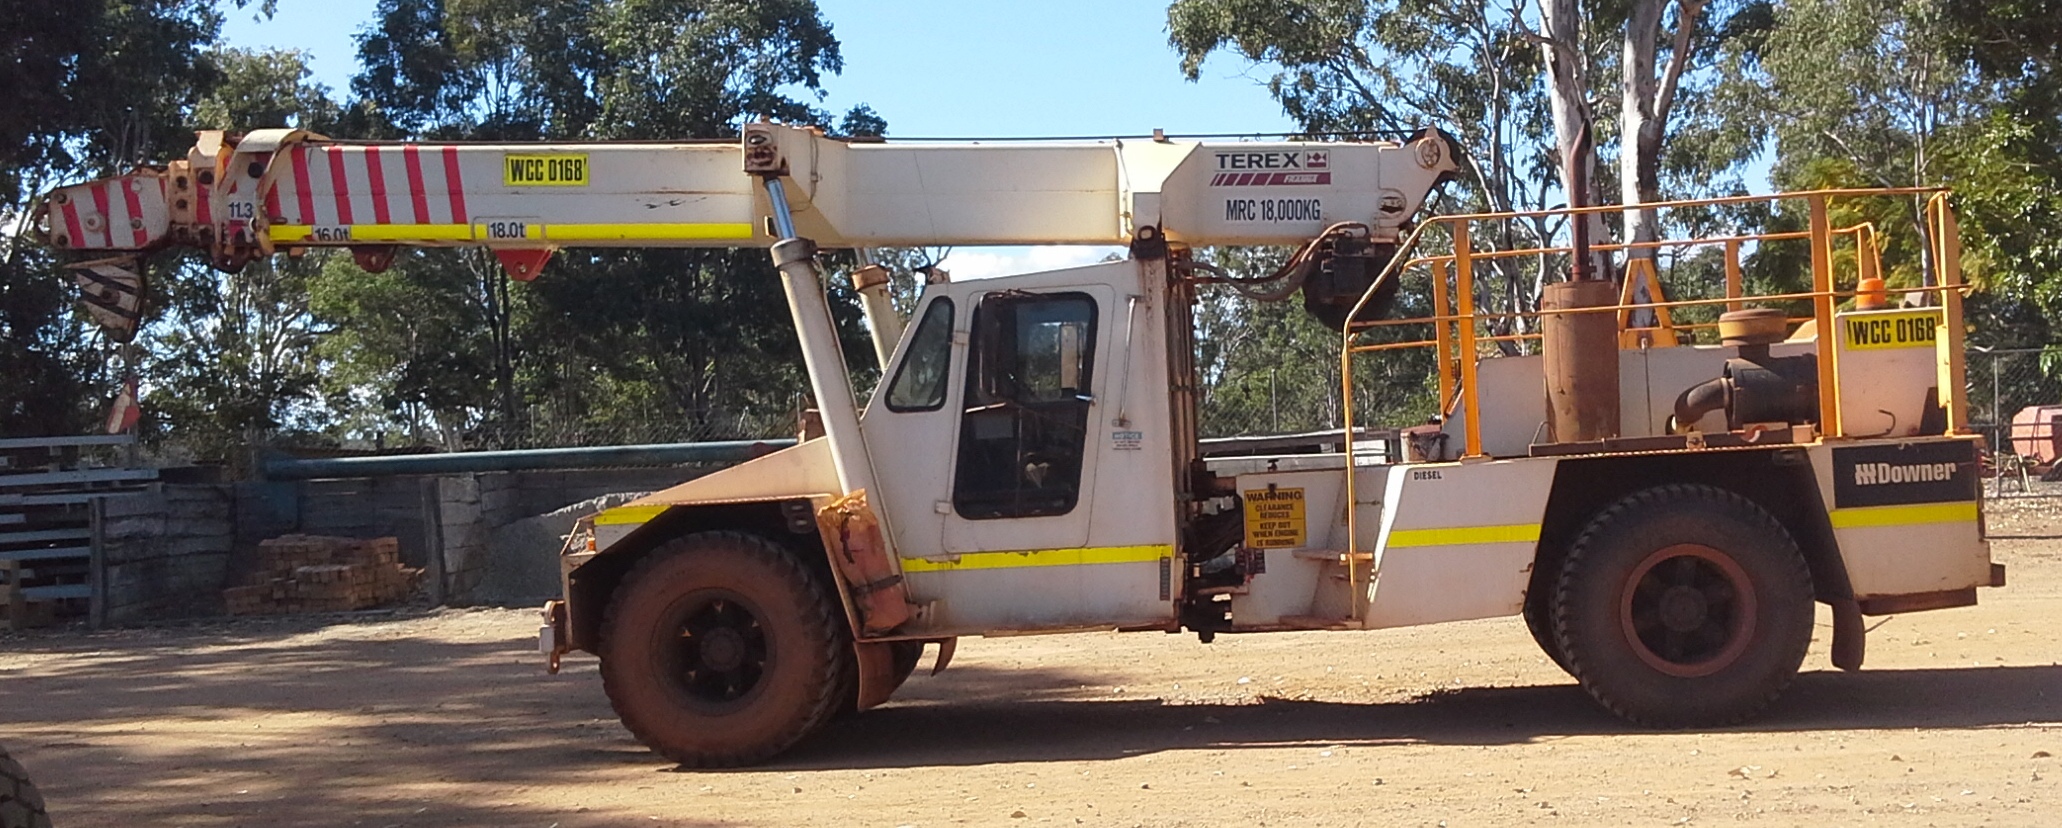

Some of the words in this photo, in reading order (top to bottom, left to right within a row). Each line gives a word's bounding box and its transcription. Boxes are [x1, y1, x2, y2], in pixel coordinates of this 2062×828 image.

[1215, 153, 1301, 169] TEREX
[1226, 199, 1256, 221] MRC
[1260, 199, 1321, 224] 18,000KG
[490, 222, 526, 238] 18.0t
[1852, 320, 1891, 345] WCC
[1896, 317, 1936, 342] 0168
[1413, 471, 1442, 480] DIESEL
[1877, 462, 1957, 484] Downer
[1246, 491, 1302, 501] WARNING
[1260, 522, 1276, 530] KEEP
